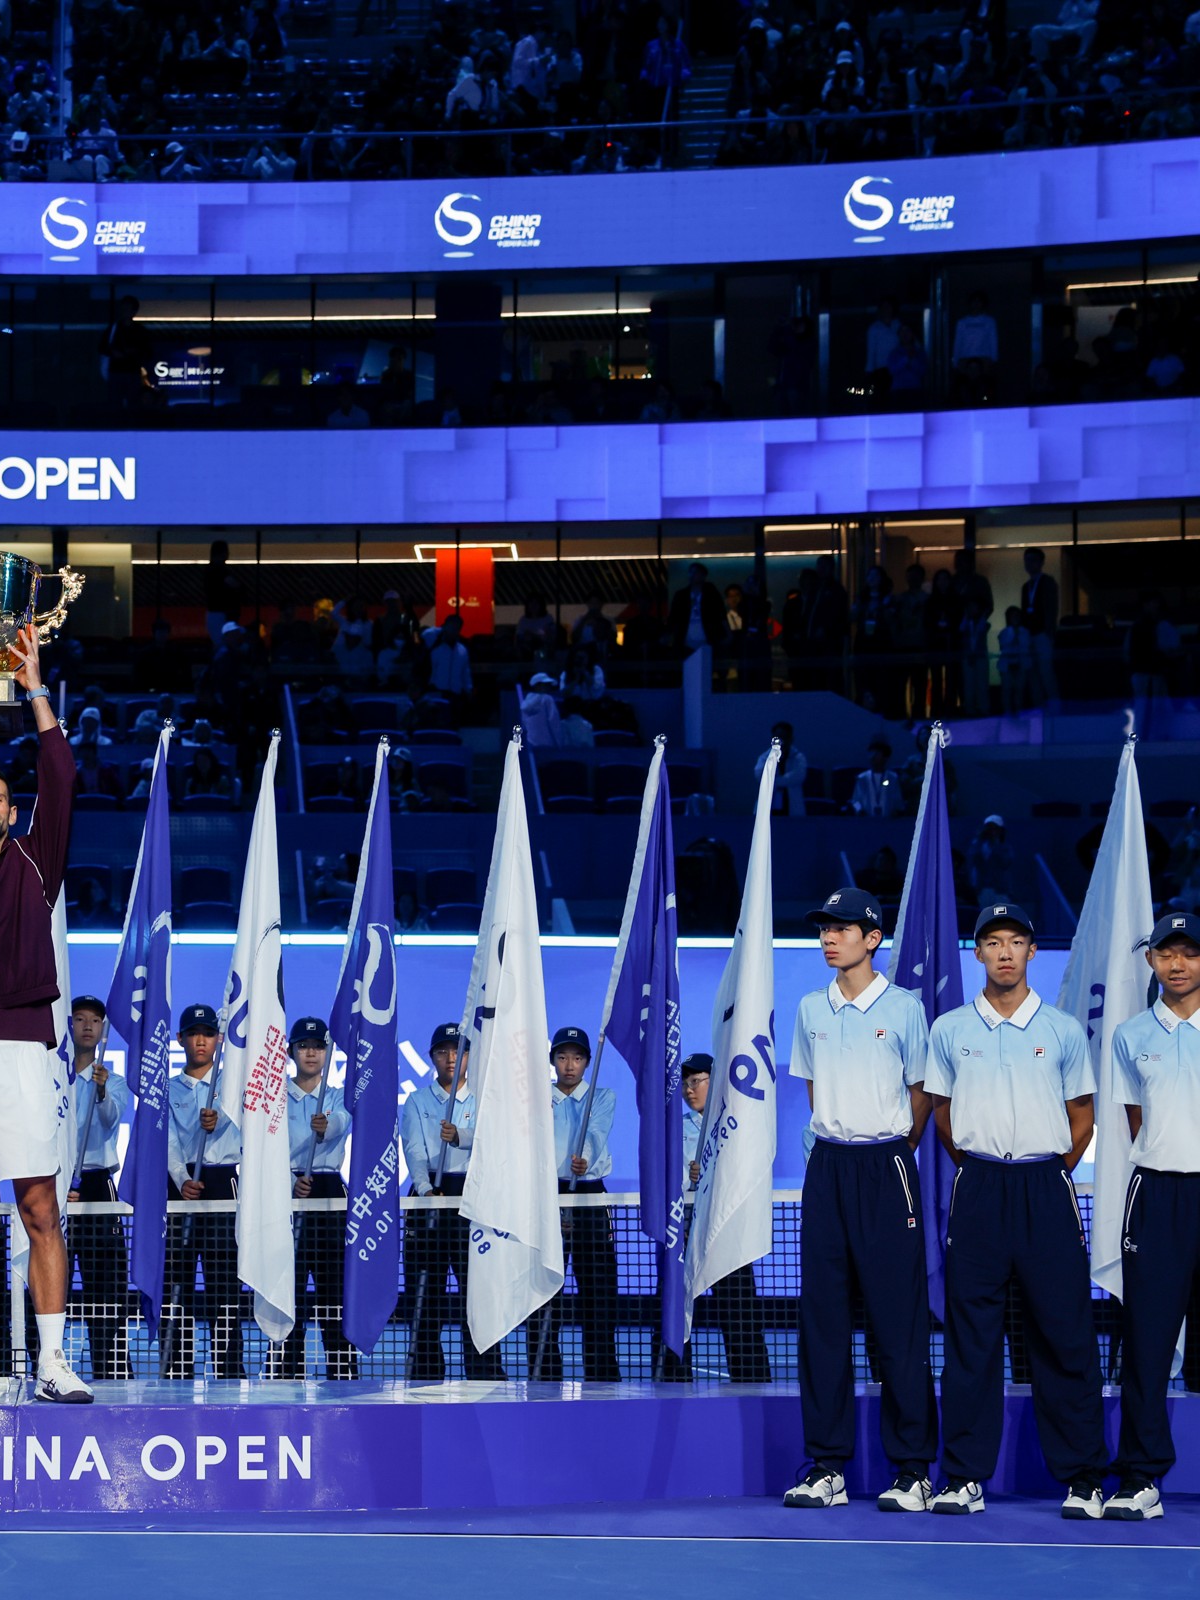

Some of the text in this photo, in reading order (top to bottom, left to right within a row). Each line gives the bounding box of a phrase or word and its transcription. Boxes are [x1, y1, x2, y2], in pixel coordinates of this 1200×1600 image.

[901, 195, 956, 212] CHINA
[490, 214, 542, 228] CHINA
[898, 208, 949, 224] OPEN
[95, 221, 147, 234] CHINA
[487, 227, 536, 240] OPEN
[93, 232, 141, 246] OPEN
[141, 1434, 312, 1482] OPEN
